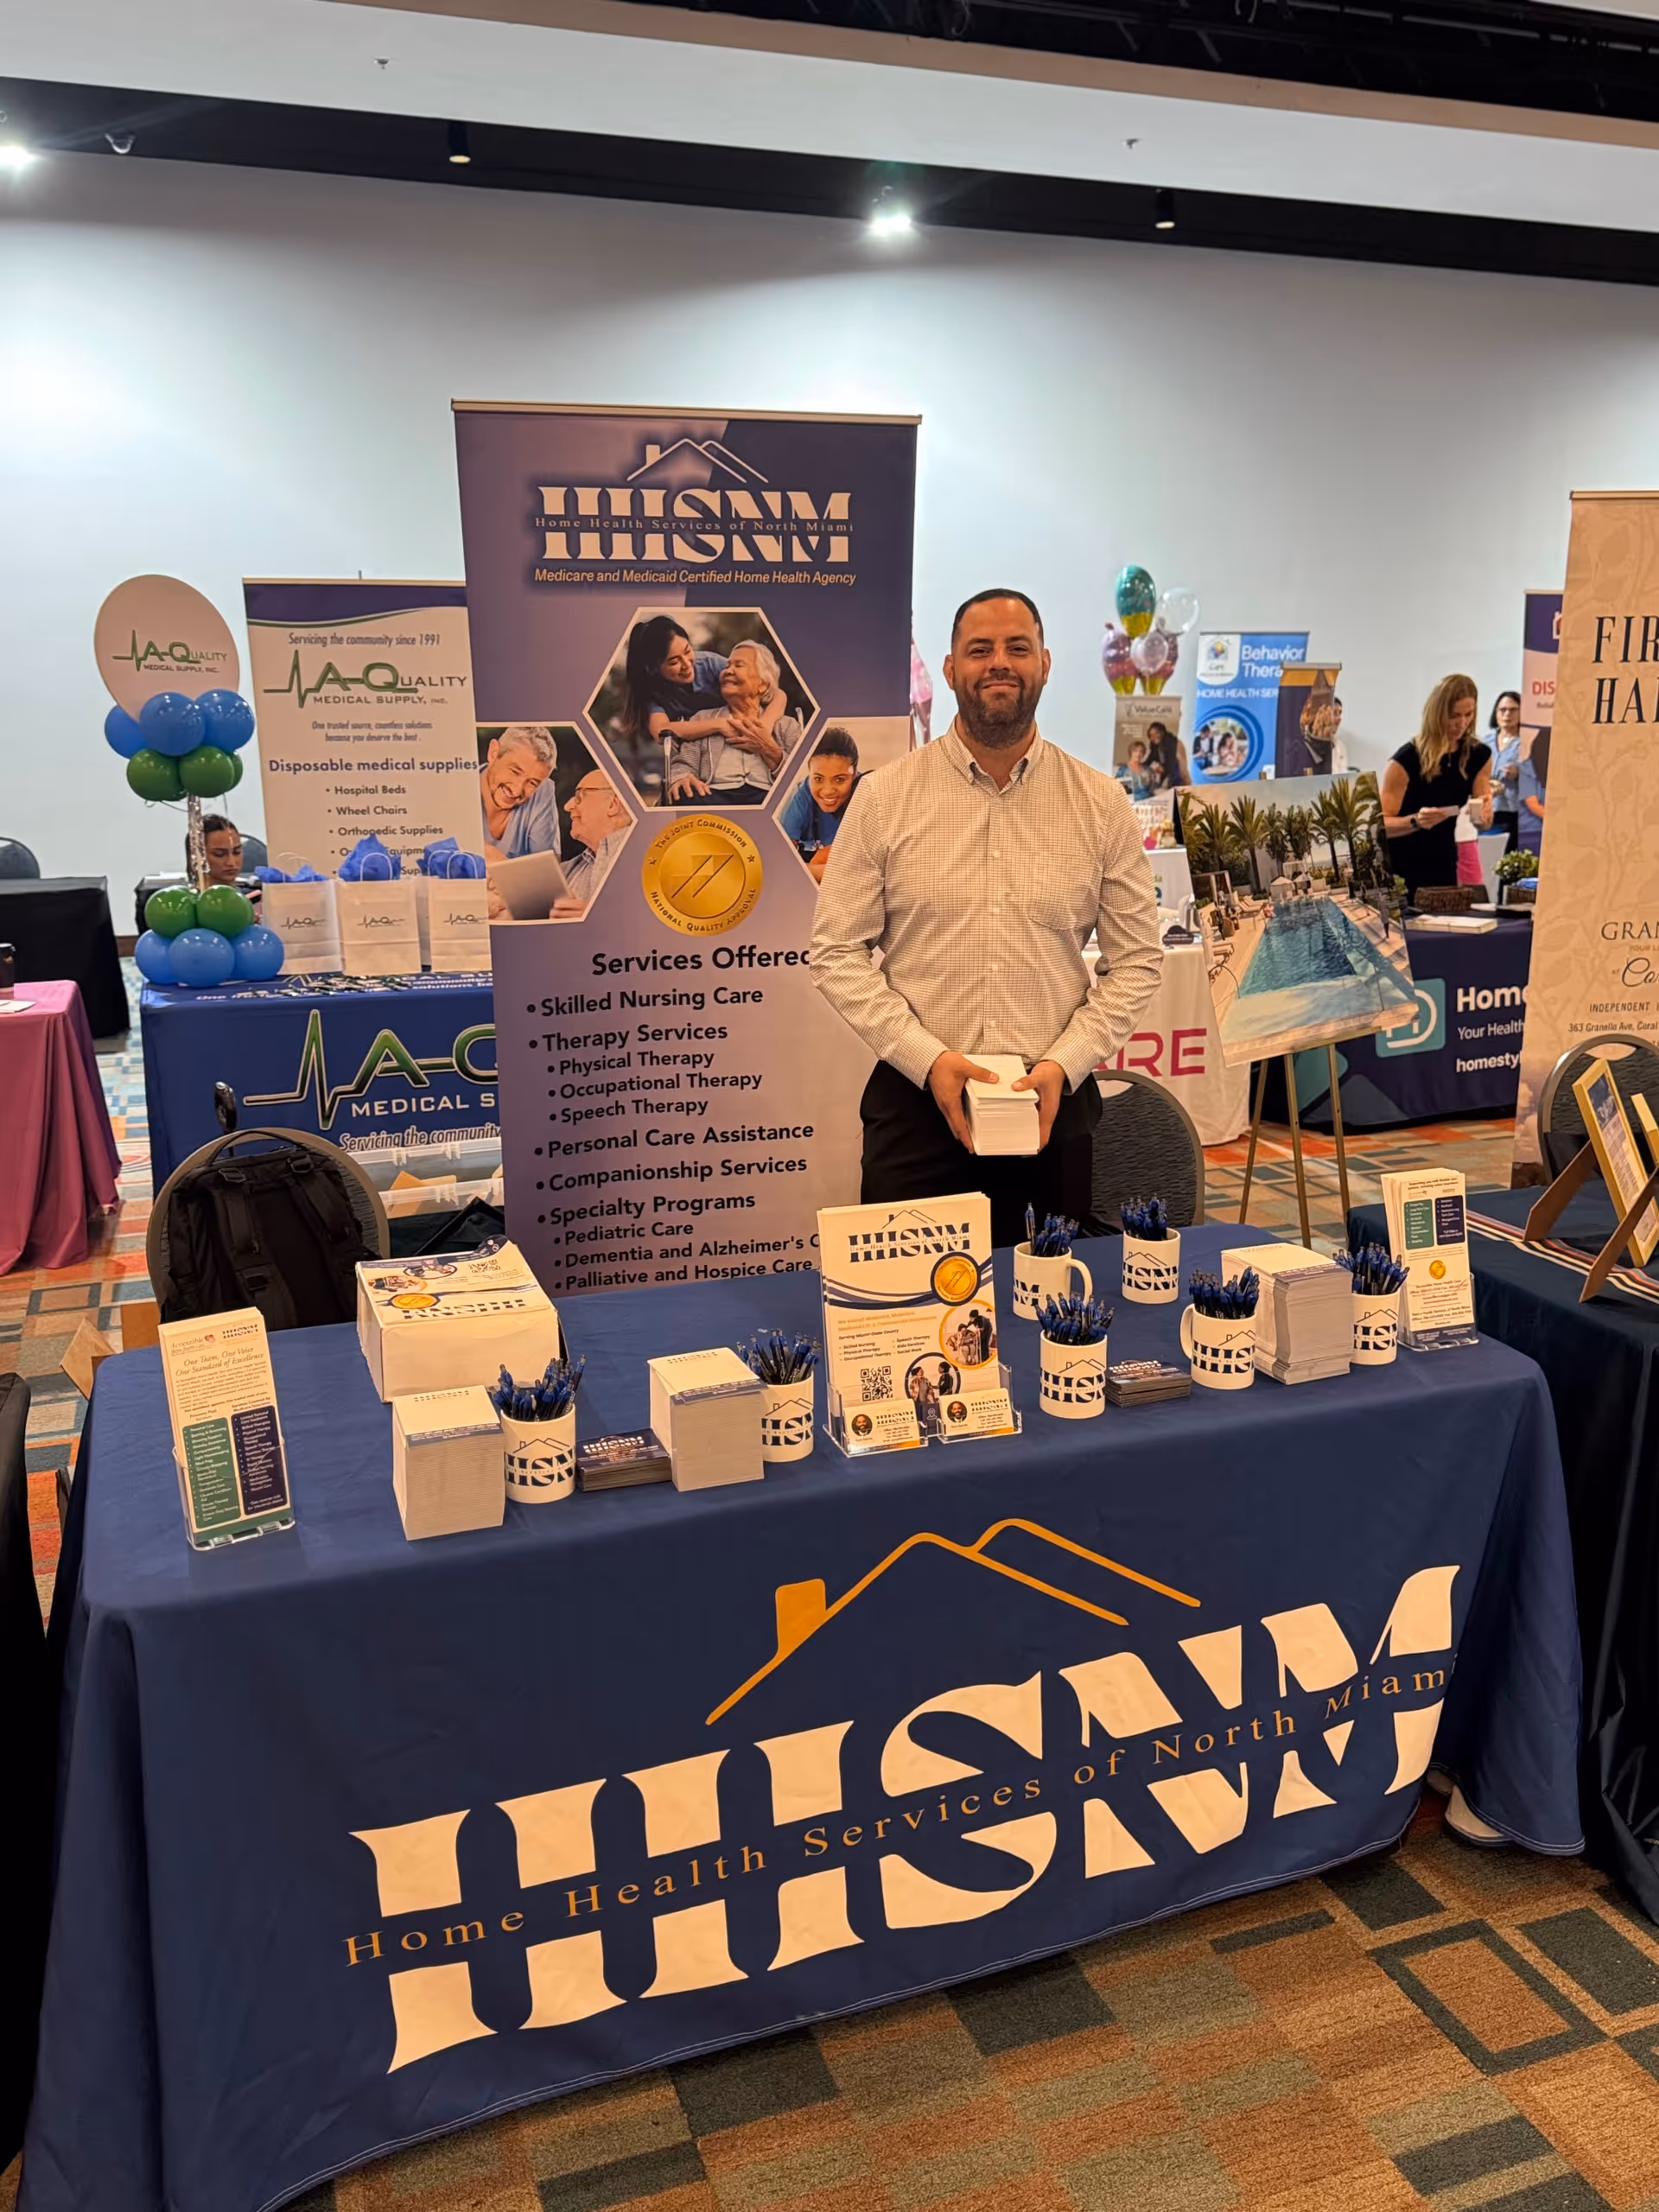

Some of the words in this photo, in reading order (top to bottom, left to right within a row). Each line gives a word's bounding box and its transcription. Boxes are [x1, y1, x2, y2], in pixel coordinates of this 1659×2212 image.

[535, 518, 581, 529] Home
[590, 518, 643, 530] Health
[652, 519, 721, 531] Services
[729, 520, 746, 531] of
[753, 521, 798, 531] North
[806, 522, 855, 532] Miami
[537, 486, 851, 563] HHSNM
[534, 568, 594, 582] Medicare
[596, 569, 620, 582] and
[622, 569, 677, 583] Medicaid
[679, 570, 732, 583] Certified
[734, 571, 771, 583] Home
[772, 571, 810, 584] Health
[812, 571, 856, 587] Agency
[289, 632, 327, 647] Servicing
[331, 632, 345, 645] the
[346, 634, 393, 647] community
[396, 635, 416, 645] since
[419, 633, 441, 646] 1991
[1242, 645, 1306, 660] Behavior
[1243, 663, 1284, 677] Thera
[1197, 689, 1224, 698] HOME
[1226, 688, 1260, 698] HEALTH
[1261, 688, 1279, 698] SER
[1532, 681, 1556, 696] DIS
[1591, 677, 1659, 724] HA
[313, 696, 371, 705] MEDICAL
[376, 696, 427, 706] SUPPLY,
[312, 721, 325, 730] One
[327, 721, 349, 730] trusted
[375, 721, 403, 730] countless
[352, 734, 365, 744] you
[366, 733, 391, 742] deserve
[392, 733, 403, 741] the
[269, 758, 353, 774] Disposable
[357, 758, 415, 771] medical
[419, 757, 478, 774] supplies
[334, 785, 378, 797] Hospital
[382, 785, 406, 795] Beds
[336, 806, 370, 816] Wheel
[373, 805, 408, 816] Chairs
[338, 826, 397, 836] Orthopedic
[400, 826, 443, 837] Supplies
[655, 835, 671, 849] THE
[671, 821, 694, 836] JOINT
[696, 819, 747, 848] COMMISSION
[400, 867, 421, 876] Sup
[650, 891, 682, 926] NATIONAL
[686, 922, 723, 931] QUALITY
[727, 888, 756, 925] APPROVAL
[592, 950, 702, 975] Services
[540, 992, 612, 1016] Skilled
[620, 988, 706, 1010] Nursing
[714, 986, 764, 1005] Care
[1456, 985, 1529, 1013] Hom
[1590, 1001, 1650, 1013] INDEPENDENT
[543, 1028, 630, 1052] Therapy
[637, 1023, 728, 1043] Services
[1458, 1026, 1484, 1040] Your
[1487, 1020, 1525, 1036] Health
[1568, 1023, 1584, 1033] 363
[1586, 1022, 1617, 1032] Granello
[1637, 1020, 1658, 1030] Coral
[560, 1052, 631, 1077] Physical
[638, 1051, 715, 1068] Therapy
[560, 1073, 680, 1099] Occupational
[686, 1071, 763, 1090] Therapy
[351, 1094, 469, 1118] MEDICAL
[480, 1092, 495, 1109] S
[561, 1100, 626, 1125] Speech
[632, 1099, 709, 1116] Therapy
[340, 1130, 401, 1152] Servicing
[405, 1125, 427, 1146] the
[548, 1130, 637, 1158] Personal
[645, 1128, 695, 1147] Care
[702, 1125, 814, 1144] Assistance
[550, 1160, 713, 1191] Companionship
[721, 1156, 807, 1176] Services
[550, 1198, 645, 1227] Specialty
[653, 1193, 755, 1215] Programs
[565, 1223, 645, 1245] Pediatric
[652, 1221, 694, 1236] Care
[849, 1223, 969, 1262] HHSNM
[565, 1244, 653, 1268] Dementia
[659, 1243, 692, 1258] and
[699, 1236, 803, 1256] Alzheimer's
[565, 1269, 649, 1290] Palliative
[654, 1265, 688, 1281] and
[695, 1262, 766, 1279] Hospice
[772, 1259, 812, 1273] Care
[192, 1360, 222, 1374] Standard
[232, 1352, 264, 1364] Excellence
[238, 1346, 254, 1356] Voice
[348, 1565, 1459, 2075] HHSNM
[342, 1910, 524, 1966] Home
[564, 1846, 766, 1917] Health
[804, 1777, 1042, 1857] Services
[1073, 1750, 1125, 1785] of
[1152, 1711, 1296, 1764] North
